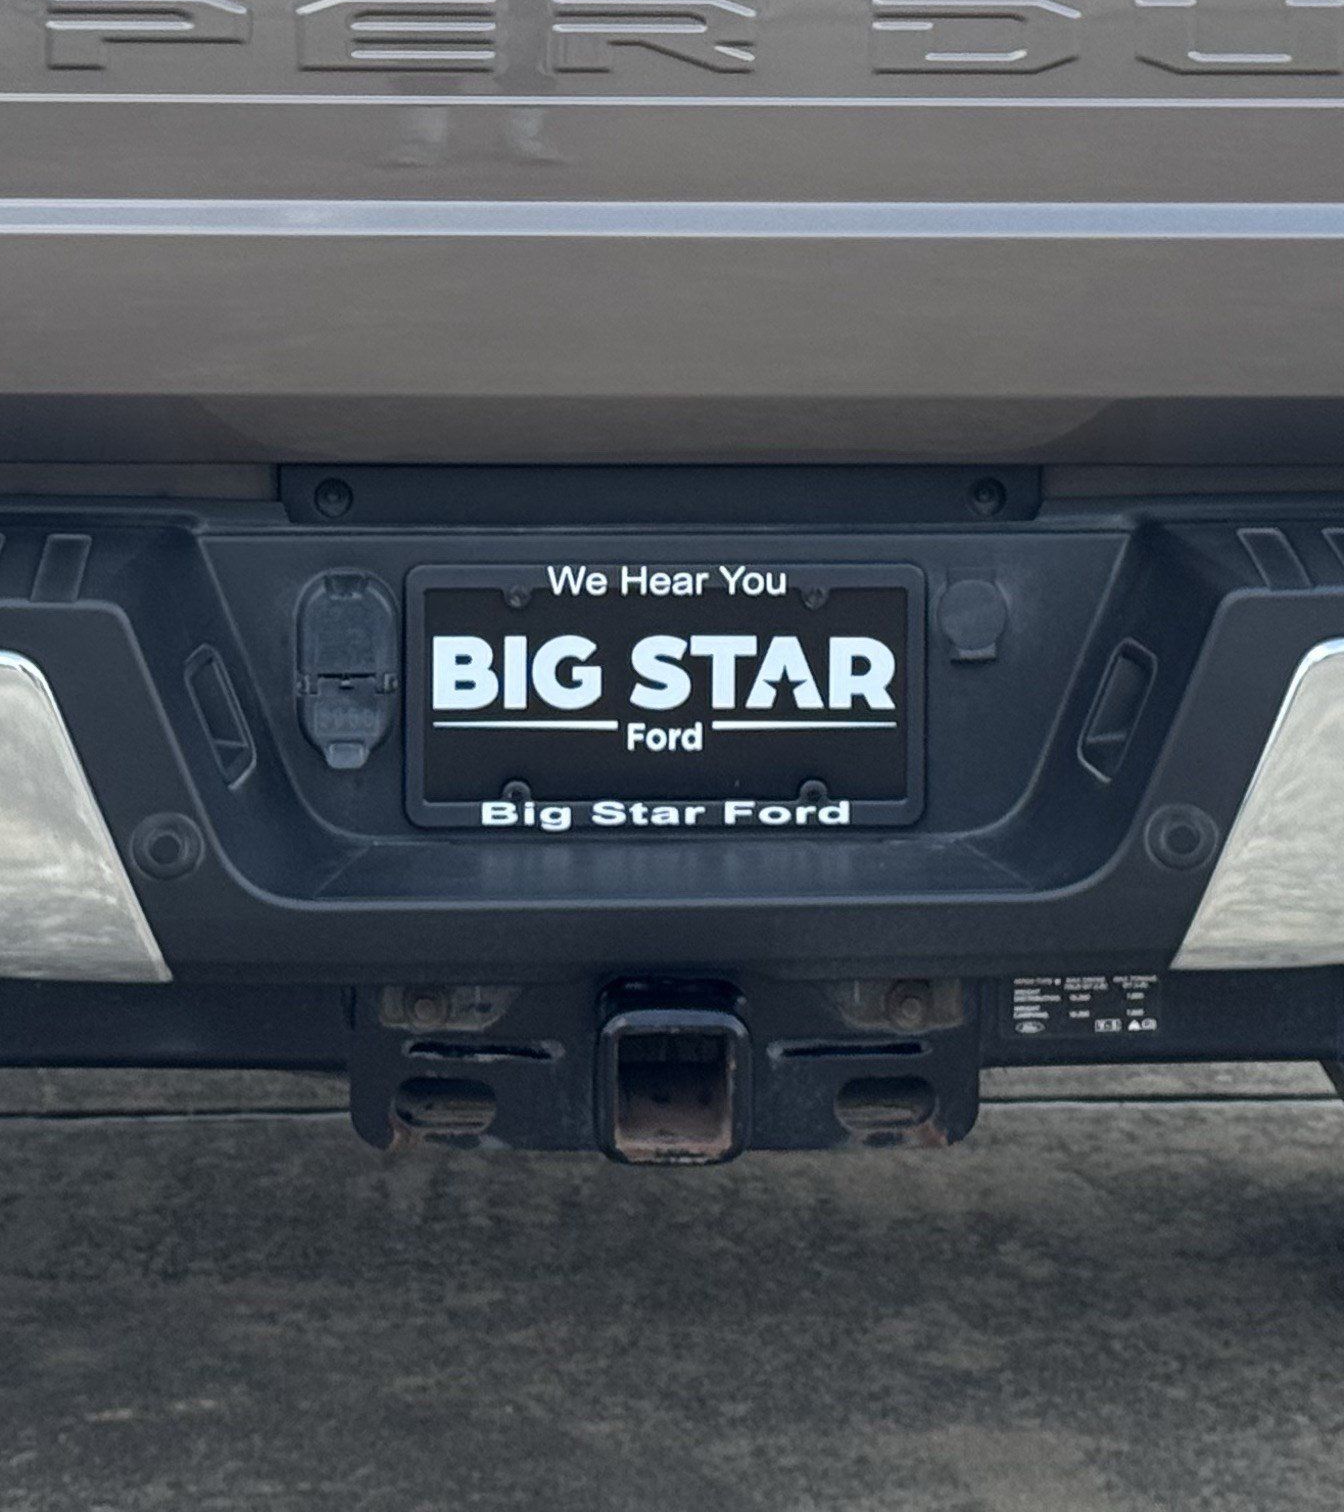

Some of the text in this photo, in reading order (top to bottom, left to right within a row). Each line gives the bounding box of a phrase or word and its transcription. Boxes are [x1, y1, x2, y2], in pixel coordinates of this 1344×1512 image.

[547, 565, 787, 596] We Hear You
[432, 634, 896, 711] BIG STAR
[627, 721, 703, 752] Ford
[481, 800, 850, 831] Big Star Ford
